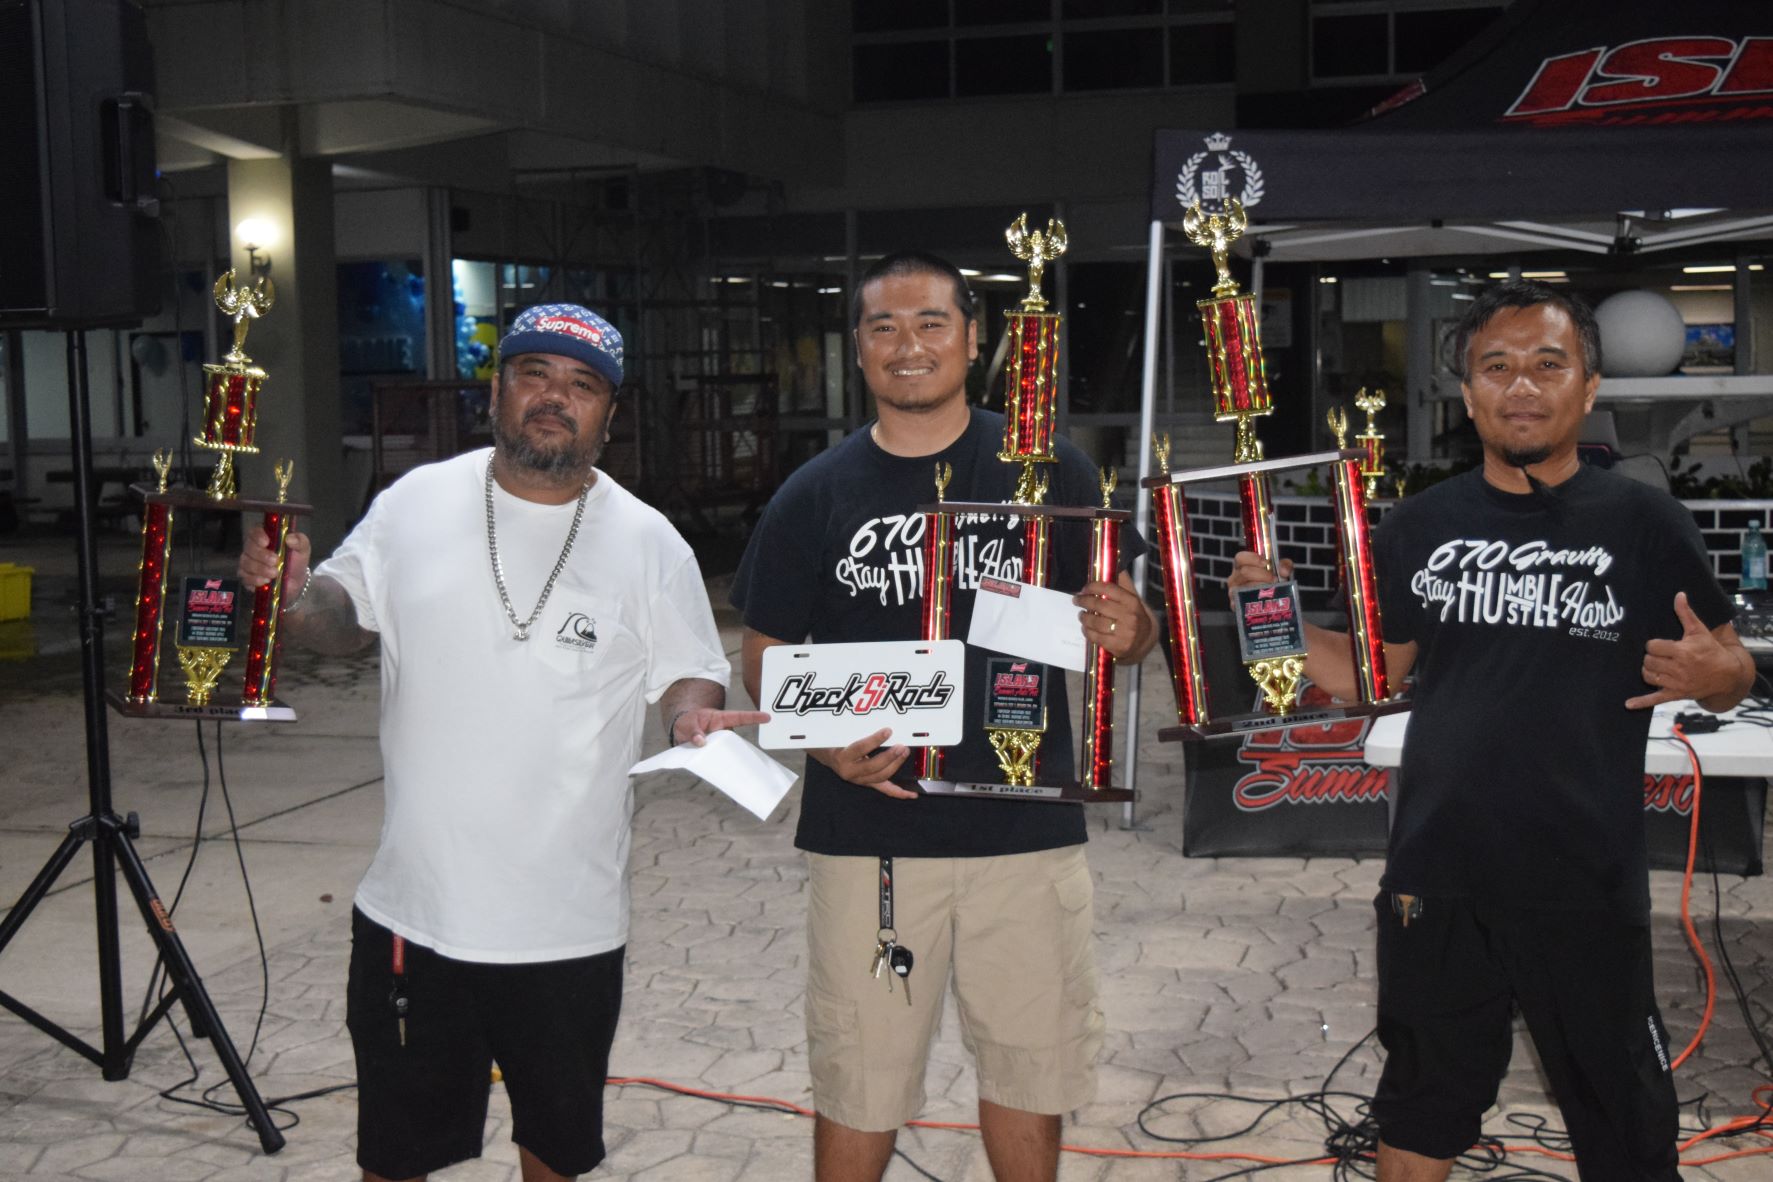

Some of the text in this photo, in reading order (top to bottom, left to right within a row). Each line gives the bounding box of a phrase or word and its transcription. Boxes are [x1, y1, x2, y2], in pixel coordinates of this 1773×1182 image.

[537, 317, 601, 342] Supreme
[849, 512, 926, 558] 670
[1428, 539, 1613, 576] 670 Gravity
[836, 556, 890, 606] Stay
[1411, 568, 1456, 622] Stay
[1560, 581, 1624, 628] Hard
[1592, 630, 1620, 642] 2012
[209, 707, 242, 716] plac
[1242, 712, 1329, 728] 2nd place
[970, 784, 1044, 794] 1st place
